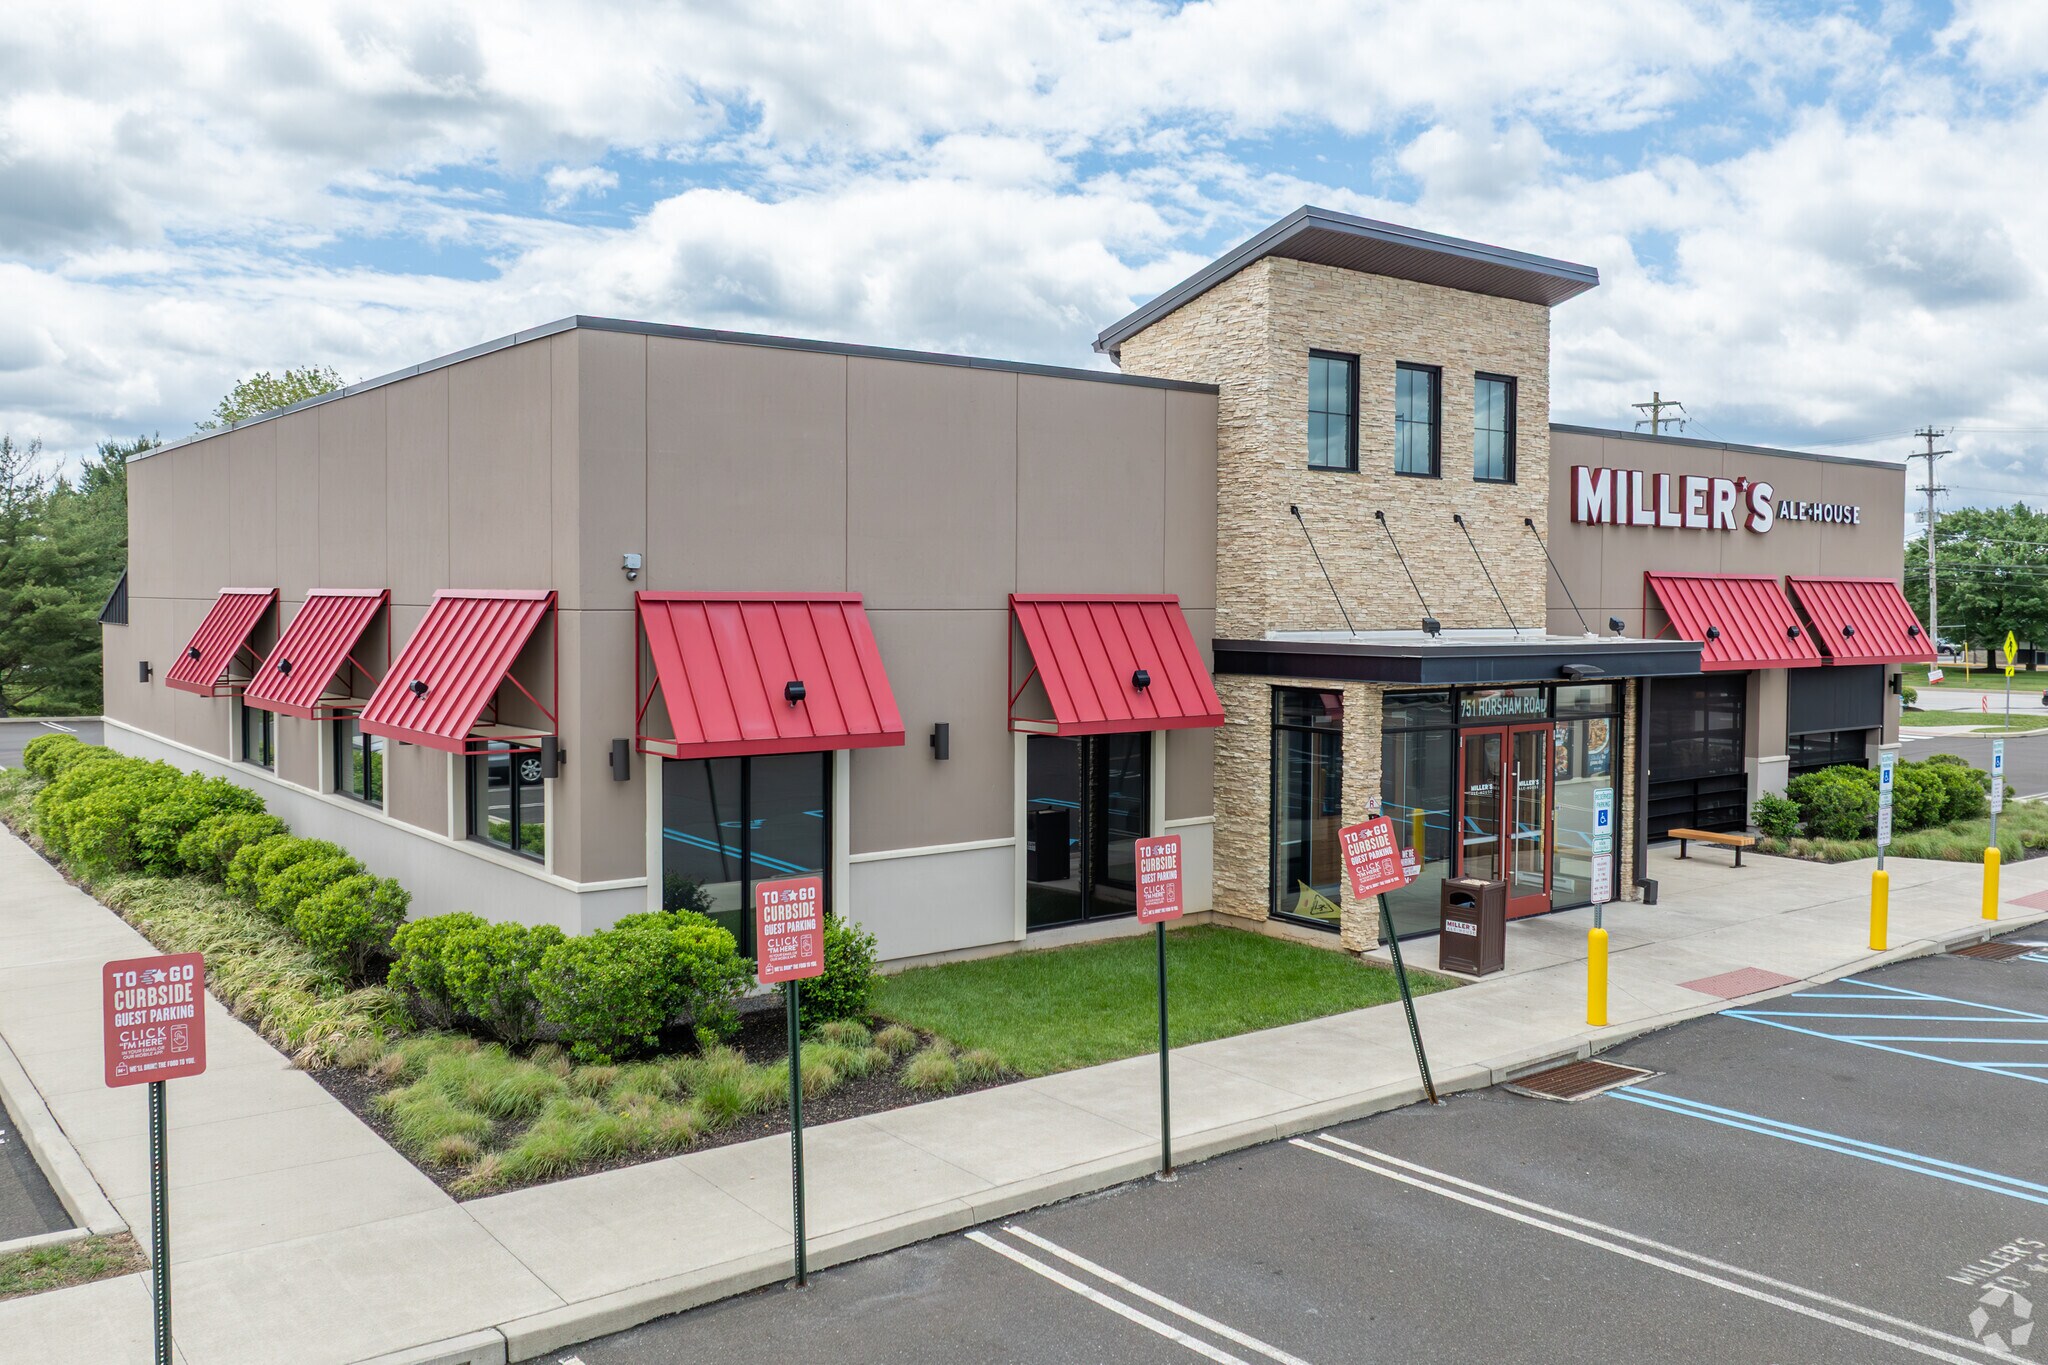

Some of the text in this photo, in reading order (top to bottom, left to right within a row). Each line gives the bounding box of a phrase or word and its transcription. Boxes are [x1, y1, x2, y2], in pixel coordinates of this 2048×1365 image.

[1571, 465, 1774, 533] MILLER'S
[1777, 500, 1861, 525] ALE HOUSE
[1461, 696, 1547, 718] 751 HORSHAM ROAD
[1344, 823, 1388, 843] TO GO
[1140, 842, 1177, 858] TO GO
[1348, 834, 1391, 856] CURBSIDE
[1141, 855, 1177, 873] CURBSIDE
[1350, 854, 1368, 866] GUEST
[1368, 846, 1393, 862] PARKING
[1355, 861, 1381, 873] CLICK
[1141, 870, 1178, 885] GUEST PARKING
[762, 887, 816, 905] TO GO
[1143, 884, 1165, 894] CLICK
[763, 901, 816, 923] CURBSIDE
[764, 918, 816, 936] GUEST PARKING
[767, 935, 798, 948] CLICK
[112, 964, 194, 989] TO GO
[114, 982, 194, 1011] CURBSIDE
[114, 1004, 195, 1027] GUEST PARKING
[119, 1026, 167, 1042] CLICK
[135, 1051, 153, 1059] MOBILE
[129, 1064, 143, 1073] WE'LL
[1946, 1237, 2046, 1285] MILLER'S
[1981, 1276, 2031, 1295] TO
